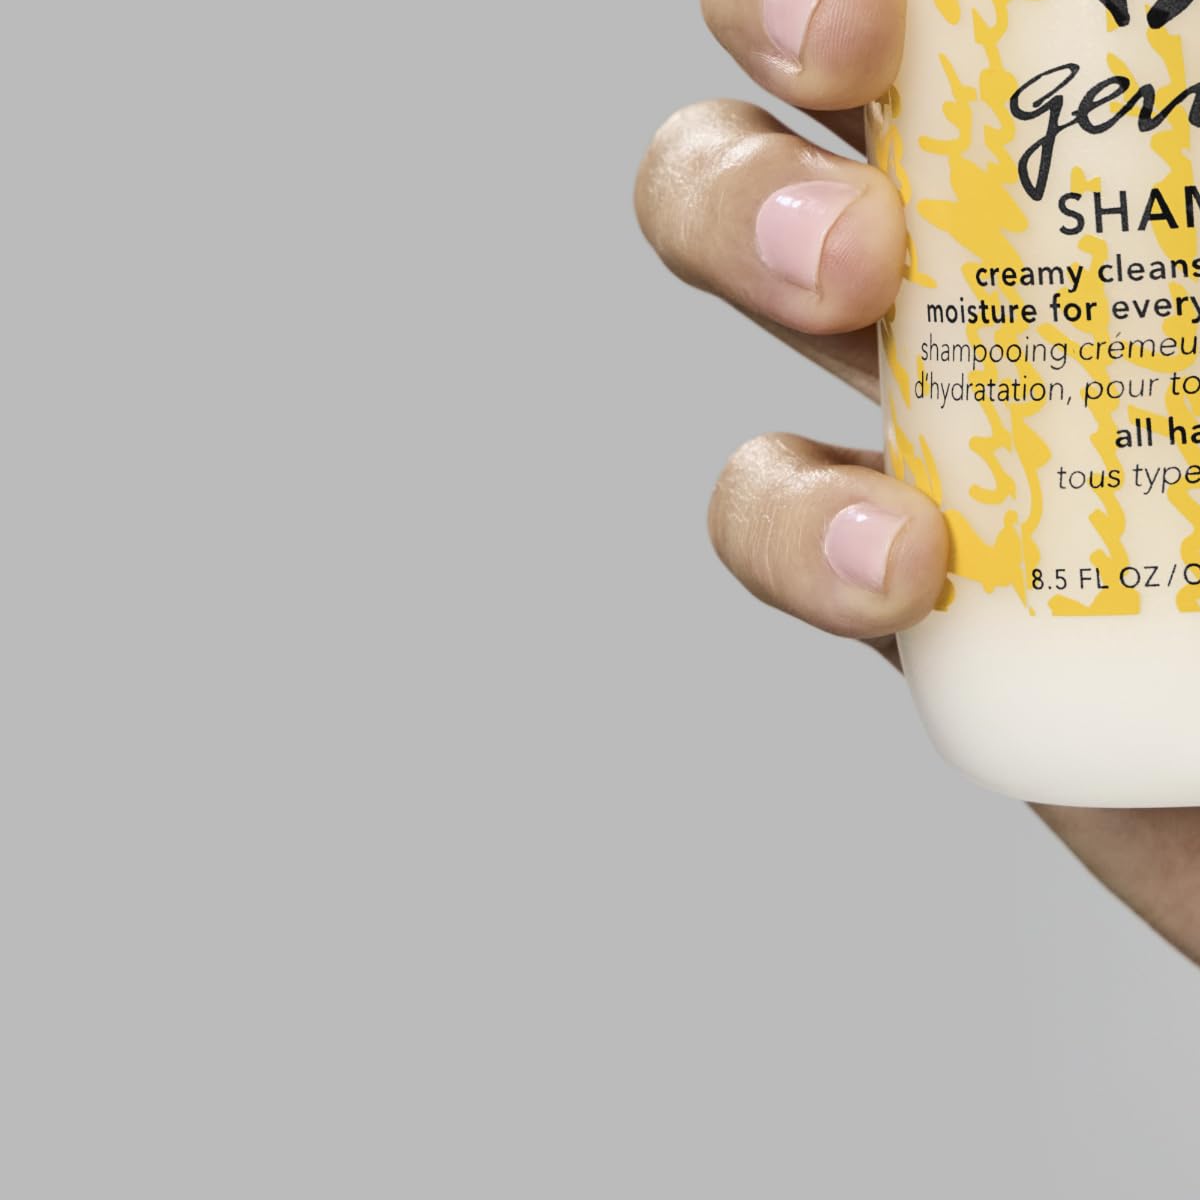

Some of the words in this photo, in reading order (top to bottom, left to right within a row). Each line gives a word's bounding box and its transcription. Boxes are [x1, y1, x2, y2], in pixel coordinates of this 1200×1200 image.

[976, 266, 1083, 293] creamy
[927, 297, 1037, 324] moisture
[1050, 293, 1097, 322] for
[922, 334, 1067, 370] shampooing
[1085, 379, 1159, 407] pour
[1116, 418, 1152, 448] all
[1057, 467, 1120, 489] tous
[1032, 569, 1066, 590] 8.5
[1080, 568, 1109, 589] FL
